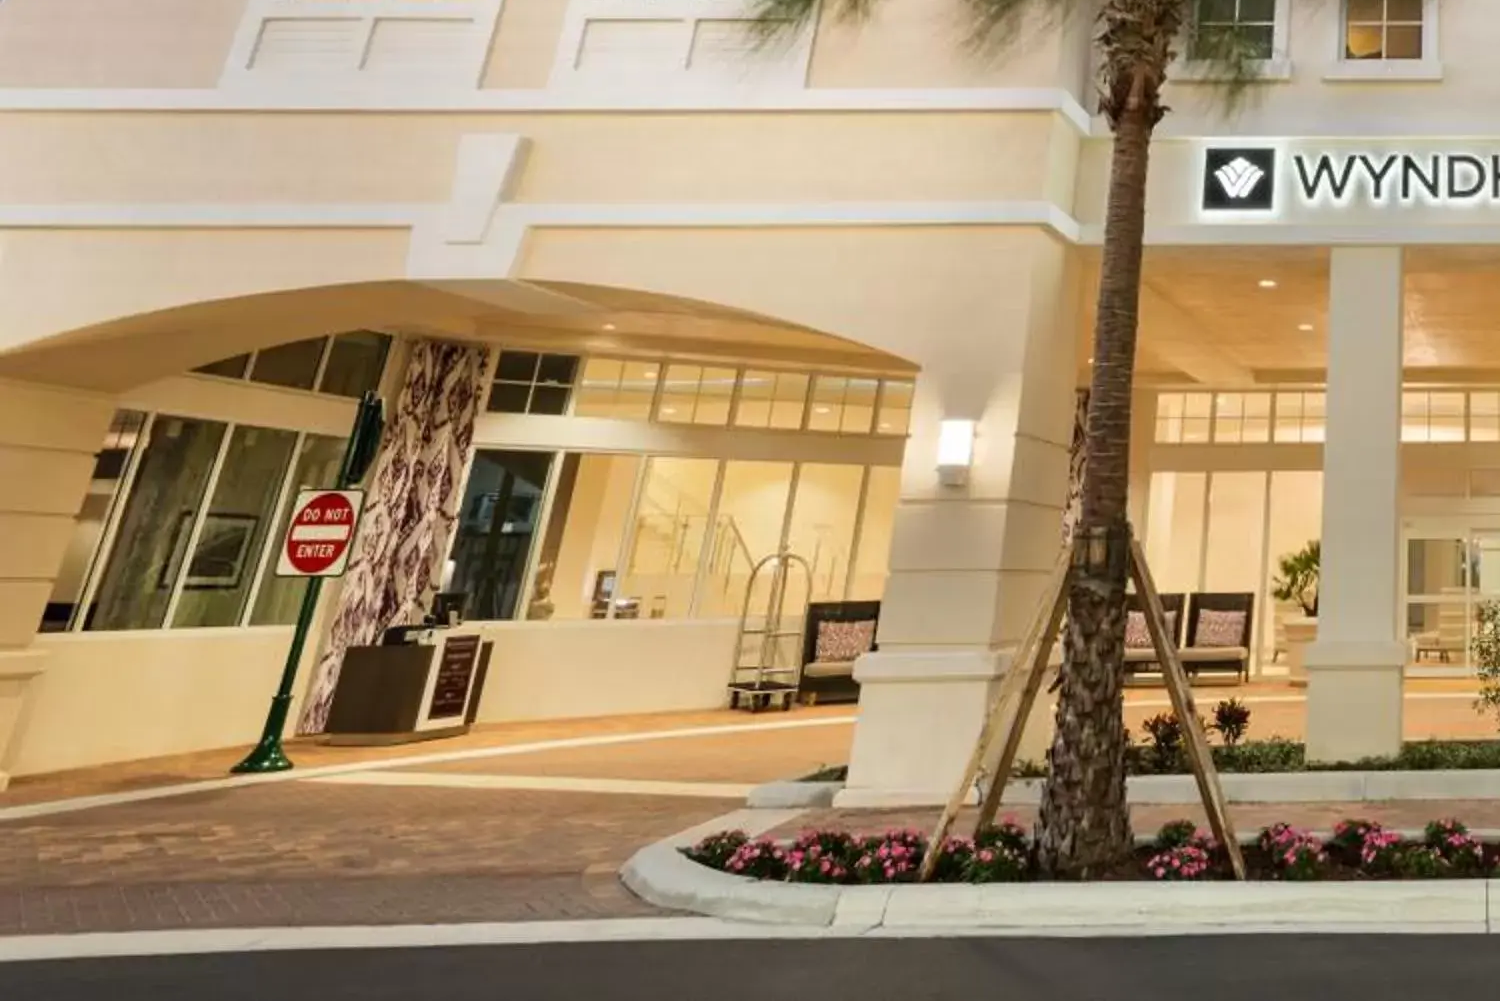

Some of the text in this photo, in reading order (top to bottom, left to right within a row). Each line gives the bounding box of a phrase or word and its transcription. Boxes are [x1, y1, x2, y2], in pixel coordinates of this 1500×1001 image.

[303, 507, 350, 522] DO NOT
[296, 544, 335, 558] ENTER
